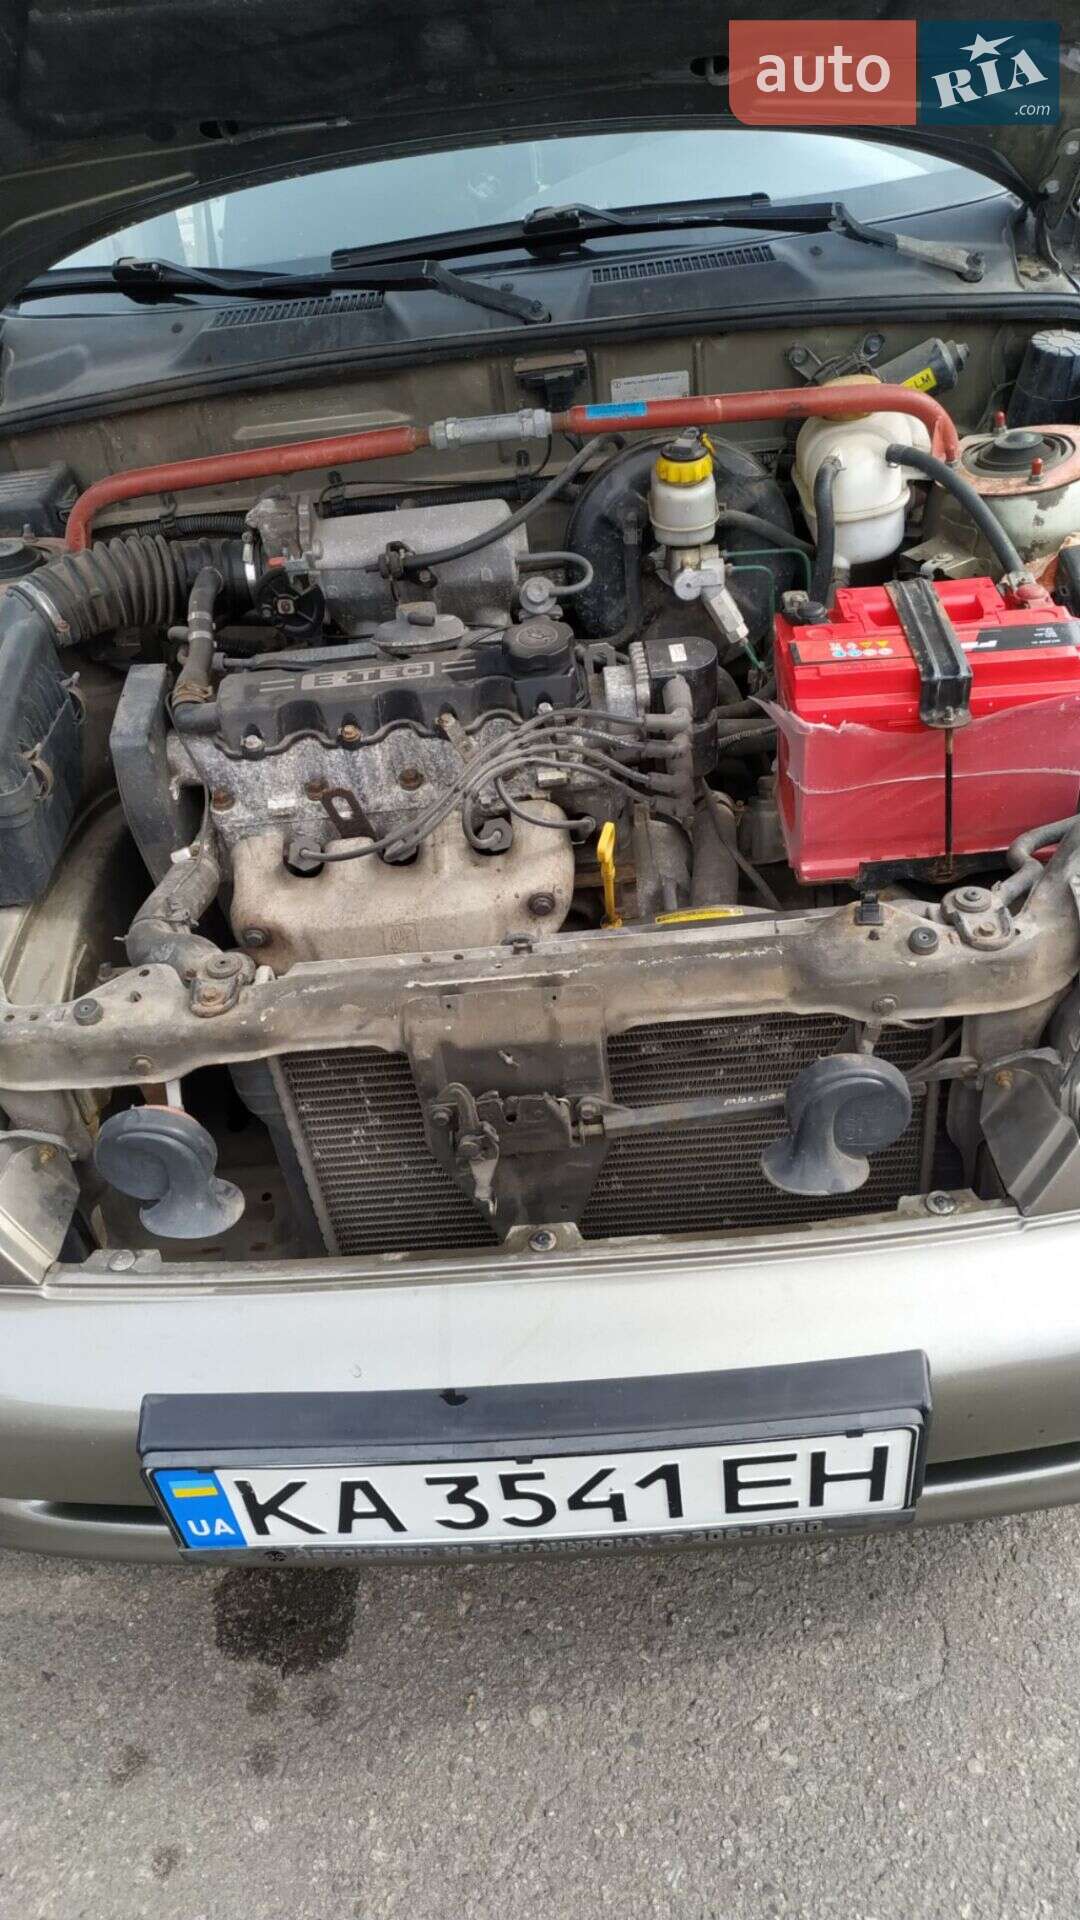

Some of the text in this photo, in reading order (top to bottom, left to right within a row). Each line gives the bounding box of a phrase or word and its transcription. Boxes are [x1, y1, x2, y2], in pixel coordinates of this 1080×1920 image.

[232, 1445, 889, 1536] KA 3541 EH
[186, 1517, 236, 1537] UA
